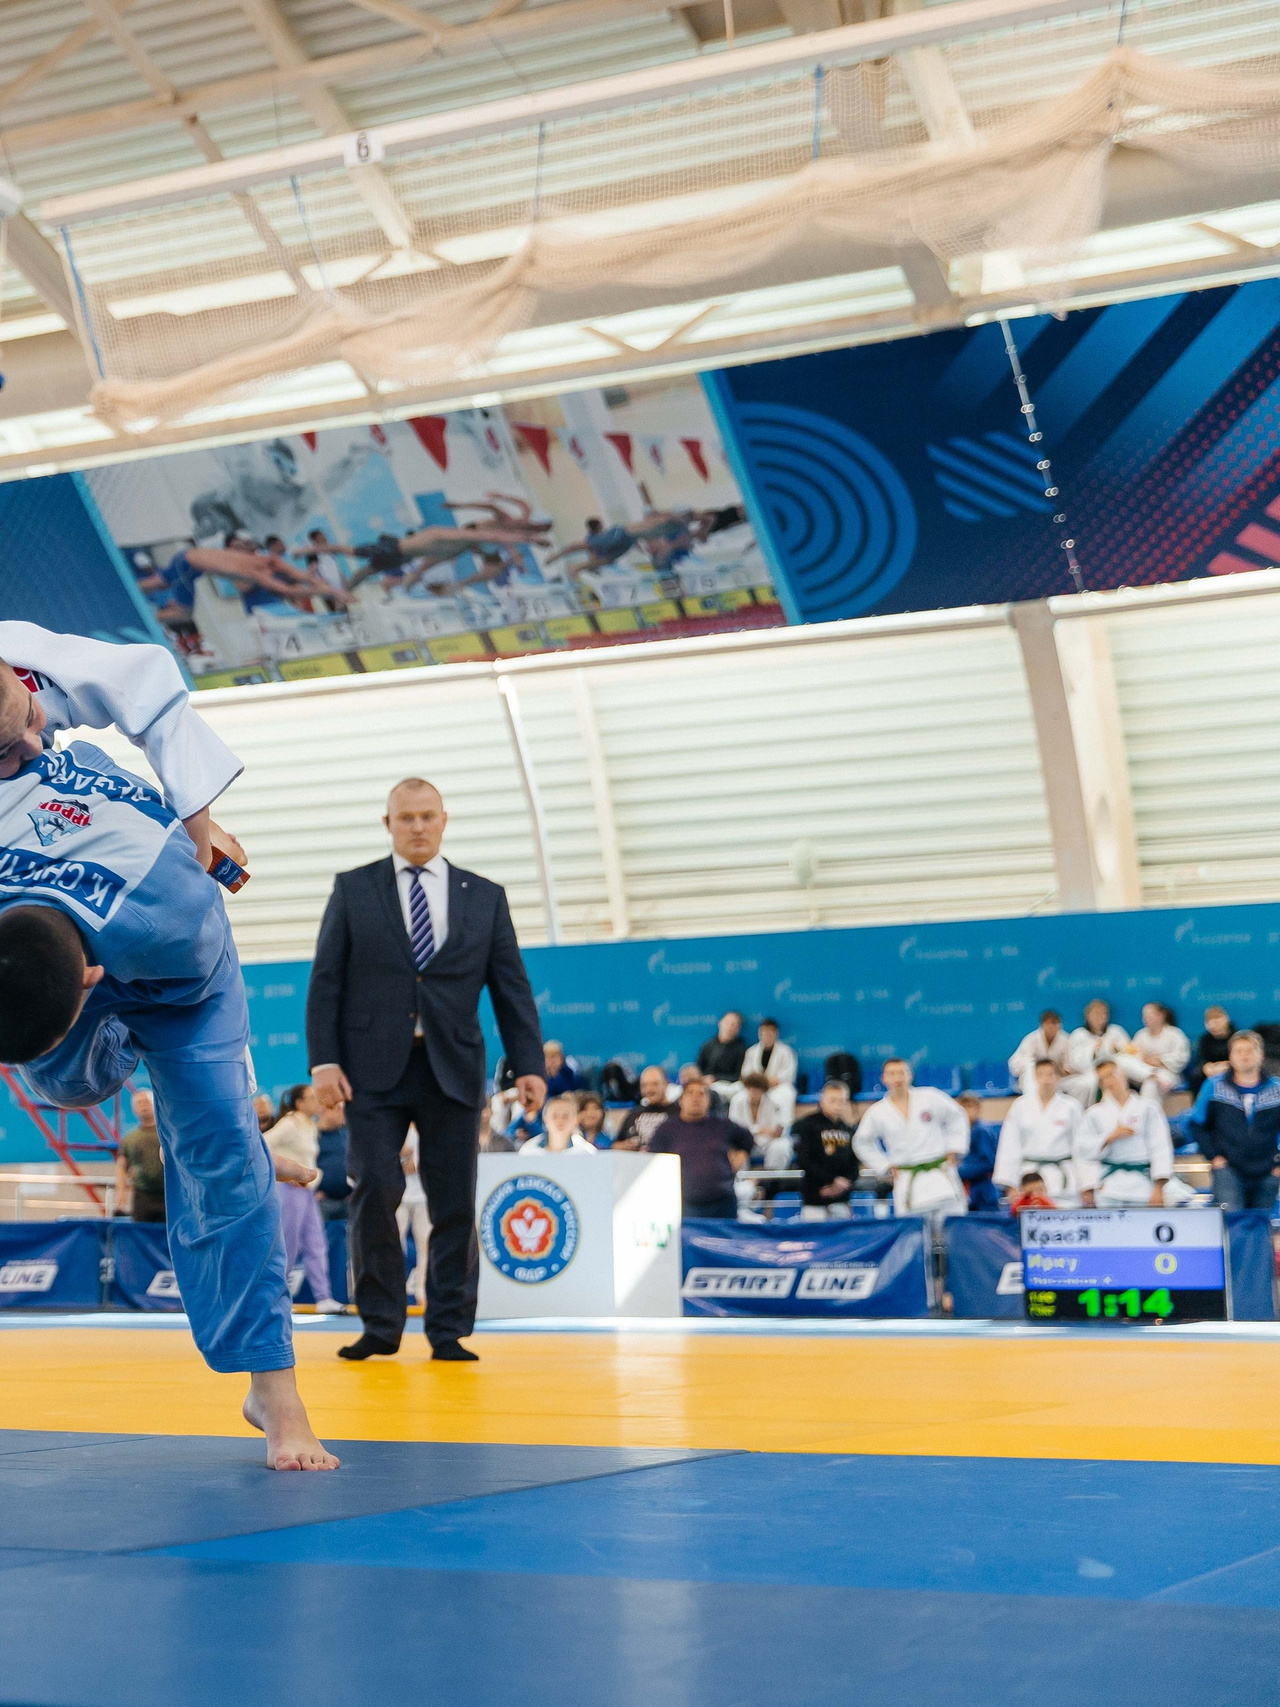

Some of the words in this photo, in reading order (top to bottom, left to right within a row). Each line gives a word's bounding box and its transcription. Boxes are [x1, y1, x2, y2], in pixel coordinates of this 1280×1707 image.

[1155, 1224, 1175, 1243] 0
[1154, 1253, 1178, 1275] 0
[691, 1272, 789, 1292] START
[804, 1272, 869, 1293] LINE
[1077, 1288, 1175, 1318] 1:14
